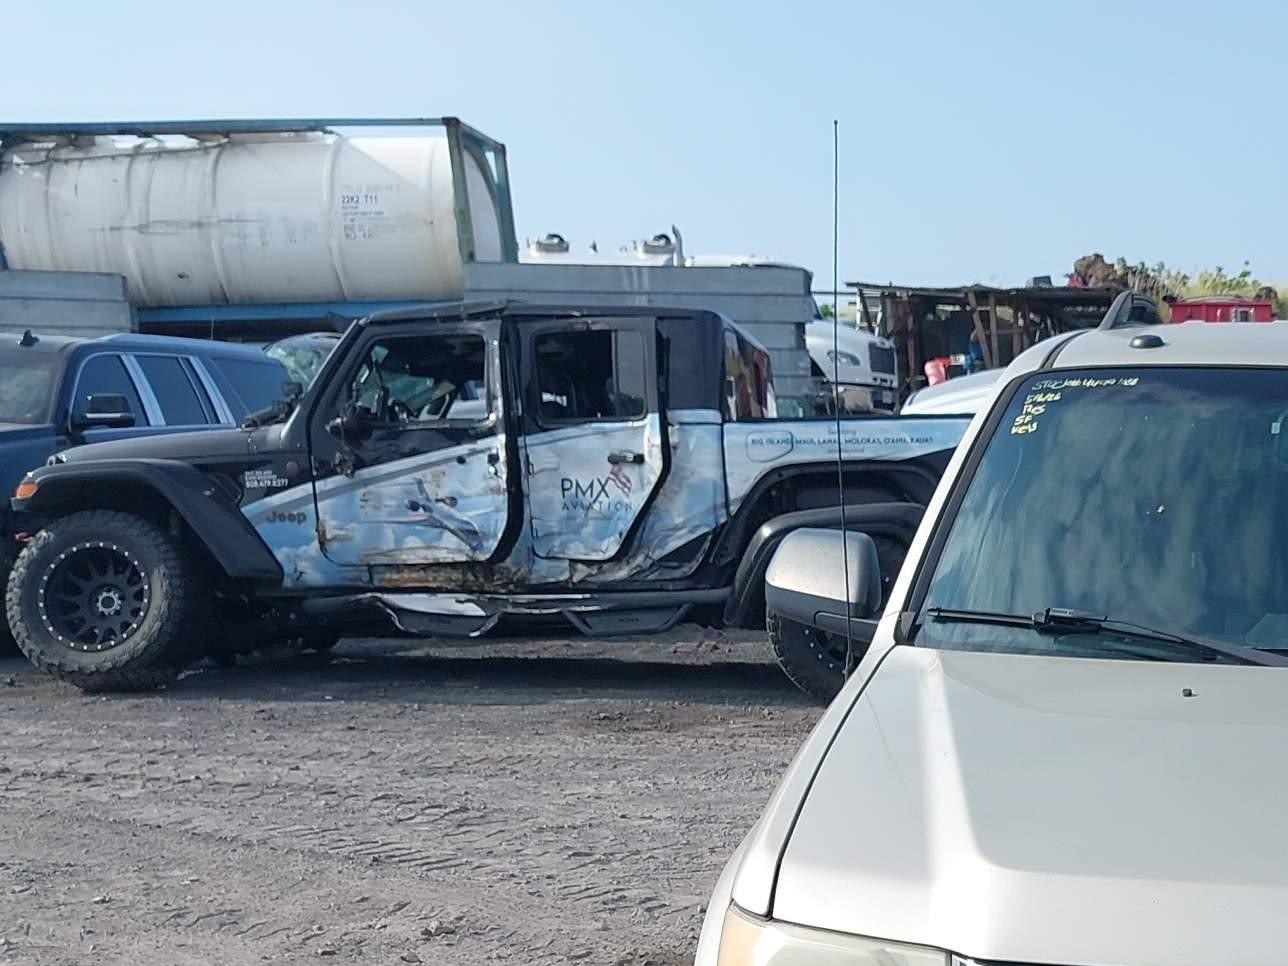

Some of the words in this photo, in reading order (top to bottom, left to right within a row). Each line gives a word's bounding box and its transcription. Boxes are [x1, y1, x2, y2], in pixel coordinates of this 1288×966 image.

[561, 477, 610, 504] PMX
[562, 501, 633, 512] AVIATION
[265, 510, 307, 526] Jeep
